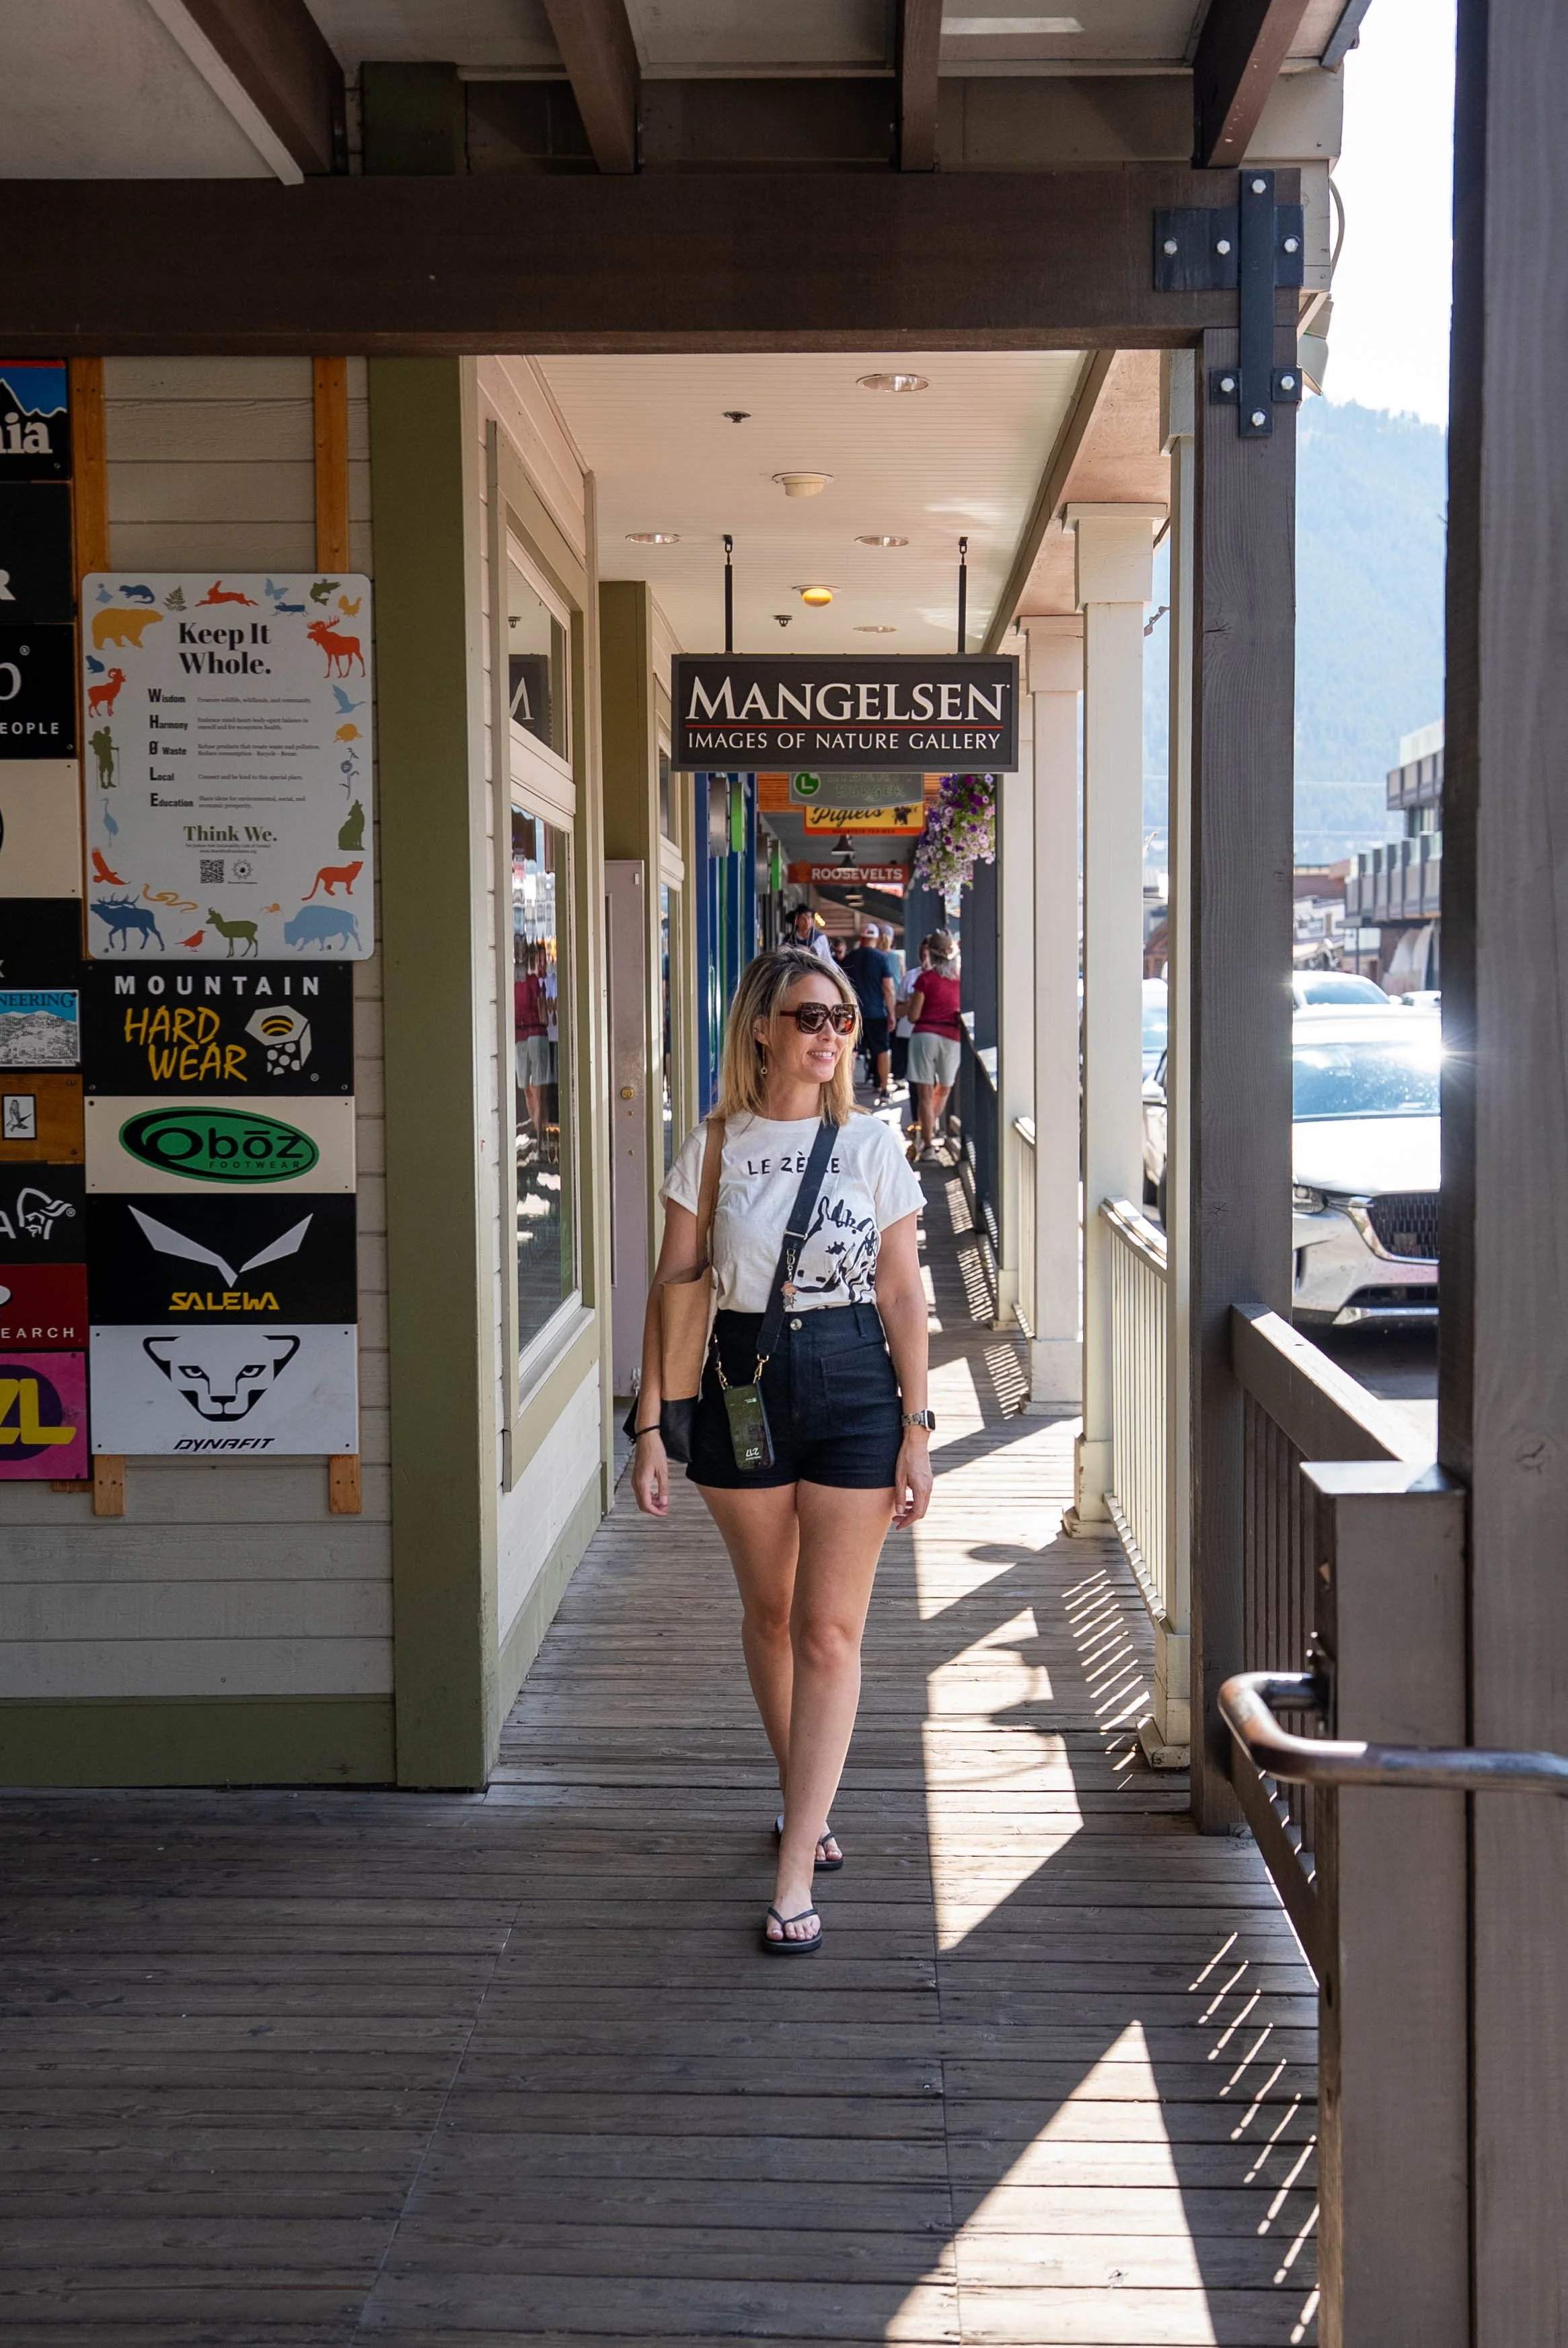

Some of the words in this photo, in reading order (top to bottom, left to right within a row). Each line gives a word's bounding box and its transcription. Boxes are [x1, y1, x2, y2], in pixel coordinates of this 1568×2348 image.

[178, 622, 244, 651] Keep
[250, 622, 272, 645] It
[178, 651, 271, 674] Whole.
[148, 688, 186, 703] Wisdom
[685, 676, 1006, 721] MANGELSEN
[149, 714, 188, 731] Harmony
[689, 733, 768, 749] IMAGES
[778, 733, 806, 749] OF
[816, 733, 899, 749] NATURE
[909, 733, 1000, 749] GALLERY
[162, 747, 187, 755] Waste
[149, 766, 175, 781] Local
[150, 793, 194, 807] Education
[183, 825, 239, 841] Think
[244, 826, 276, 841] We.
[811, 868, 904, 881] ROOSEVELTS
[115, 976, 319, 996] MOUNTAIN
[124, 1005, 221, 1044] HARD
[148, 1042, 248, 1082] WEAR
[747, 1159, 771, 1175] LE
[780, 1150, 840, 1173] ZÈE
[169, 1292, 280, 1311] SALEWA
[173, 1437, 275, 1453] DYNAFIT
